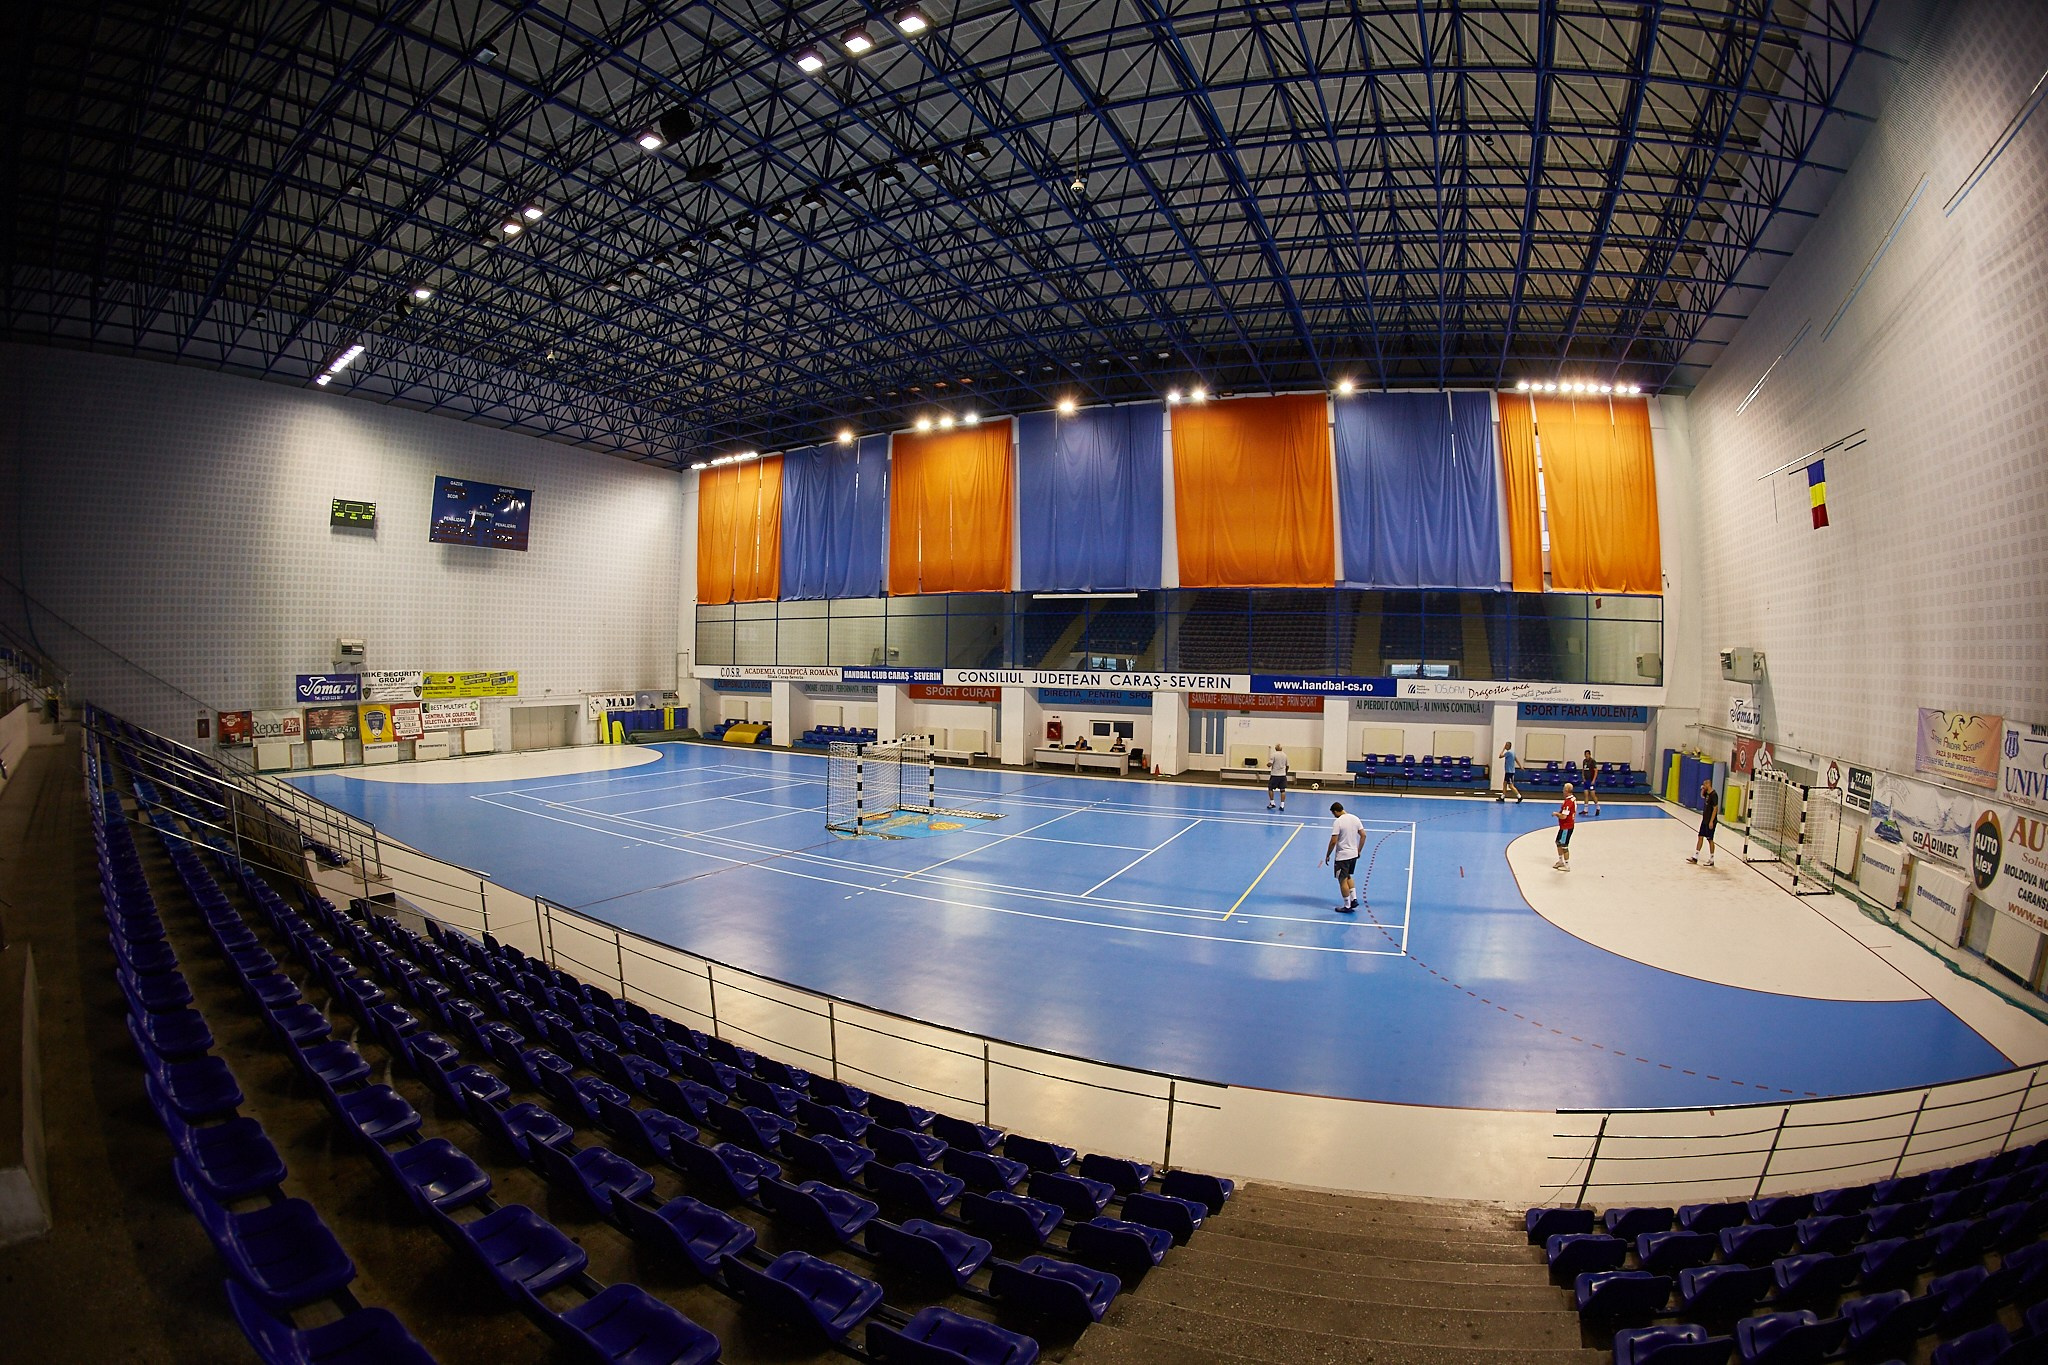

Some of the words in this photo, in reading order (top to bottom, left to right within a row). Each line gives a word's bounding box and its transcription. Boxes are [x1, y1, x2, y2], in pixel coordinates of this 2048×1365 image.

[844, 670, 871, 679] HANDBAL
[871, 671, 887, 679] CLUB
[914, 672, 941, 681] SEVERIN
[957, 672, 1023, 683] CONSILIUL
[299, 677, 357, 697] Joma.ro
[925, 687, 959, 697] SPORT
[962, 688, 996, 698] CURAT
[1274, 680, 1373, 692] www.handbal-cs.ro
[1468, 685, 1510, 699] Dragostea
[1513, 683, 1530, 692] mea
[1088, 691, 1121, 699] PENTRU
[1220, 695, 1232, 704] PRIN
[1287, 697, 1299, 706] PRIN
[1300, 697, 1317, 707] SPORT
[606, 698, 635, 707] MAD
[1356, 700, 1362, 709] AI
[1364, 700, 1389, 710] PIERDUT
[1525, 705, 1557, 716] SPORT
[1730, 700, 1760, 725] Joma.ro
[253, 722, 283, 737] Reper
[2008, 816, 2048, 852] AU
[1913, 831, 1959, 859] GRADIMEX
[1975, 833, 1998, 855] AUTO
[1975, 854, 1993, 875] Alex
[2003, 864, 2037, 889] MOLDOVA
